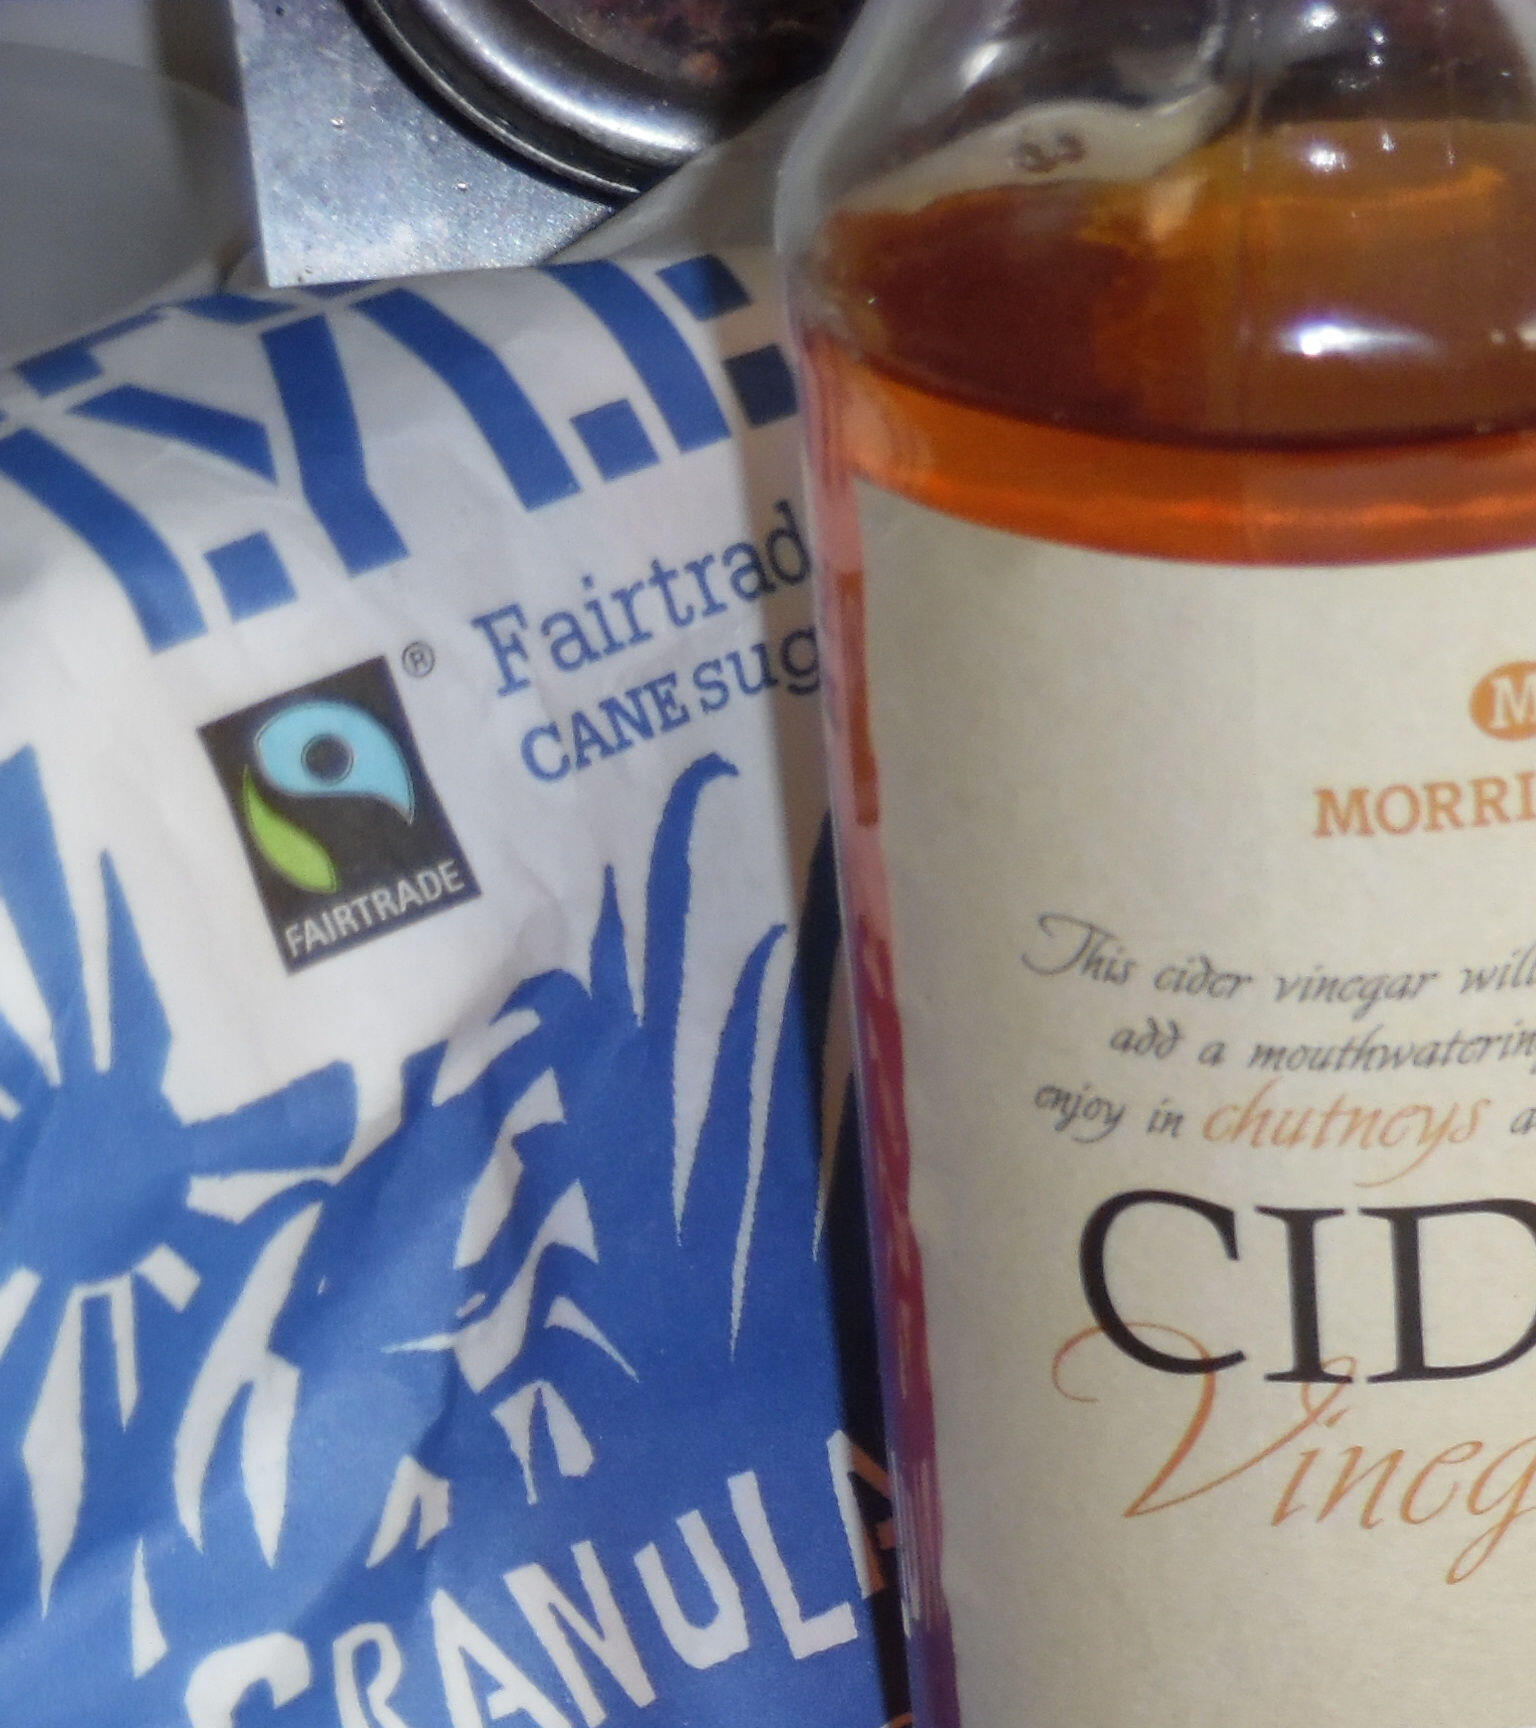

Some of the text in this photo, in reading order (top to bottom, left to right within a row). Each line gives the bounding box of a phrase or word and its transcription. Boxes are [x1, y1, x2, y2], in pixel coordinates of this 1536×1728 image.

[471, 499, 812, 697] Fairtrad
[521, 624, 821, 783] CANE sug
[285, 857, 465, 958] FAIRTRADE
[1021, 913, 1137, 985] This
[1154, 952, 1254, 1000] cider
[1274, 965, 1439, 1021] vinegar
[1108, 1018, 1186, 1061] add
[1198, 1040, 1226, 1067] a
[1034, 1083, 1127, 1144] enjoy
[1146, 1097, 1184, 1139] in
[1203, 1077, 1491, 1188] chutneys
